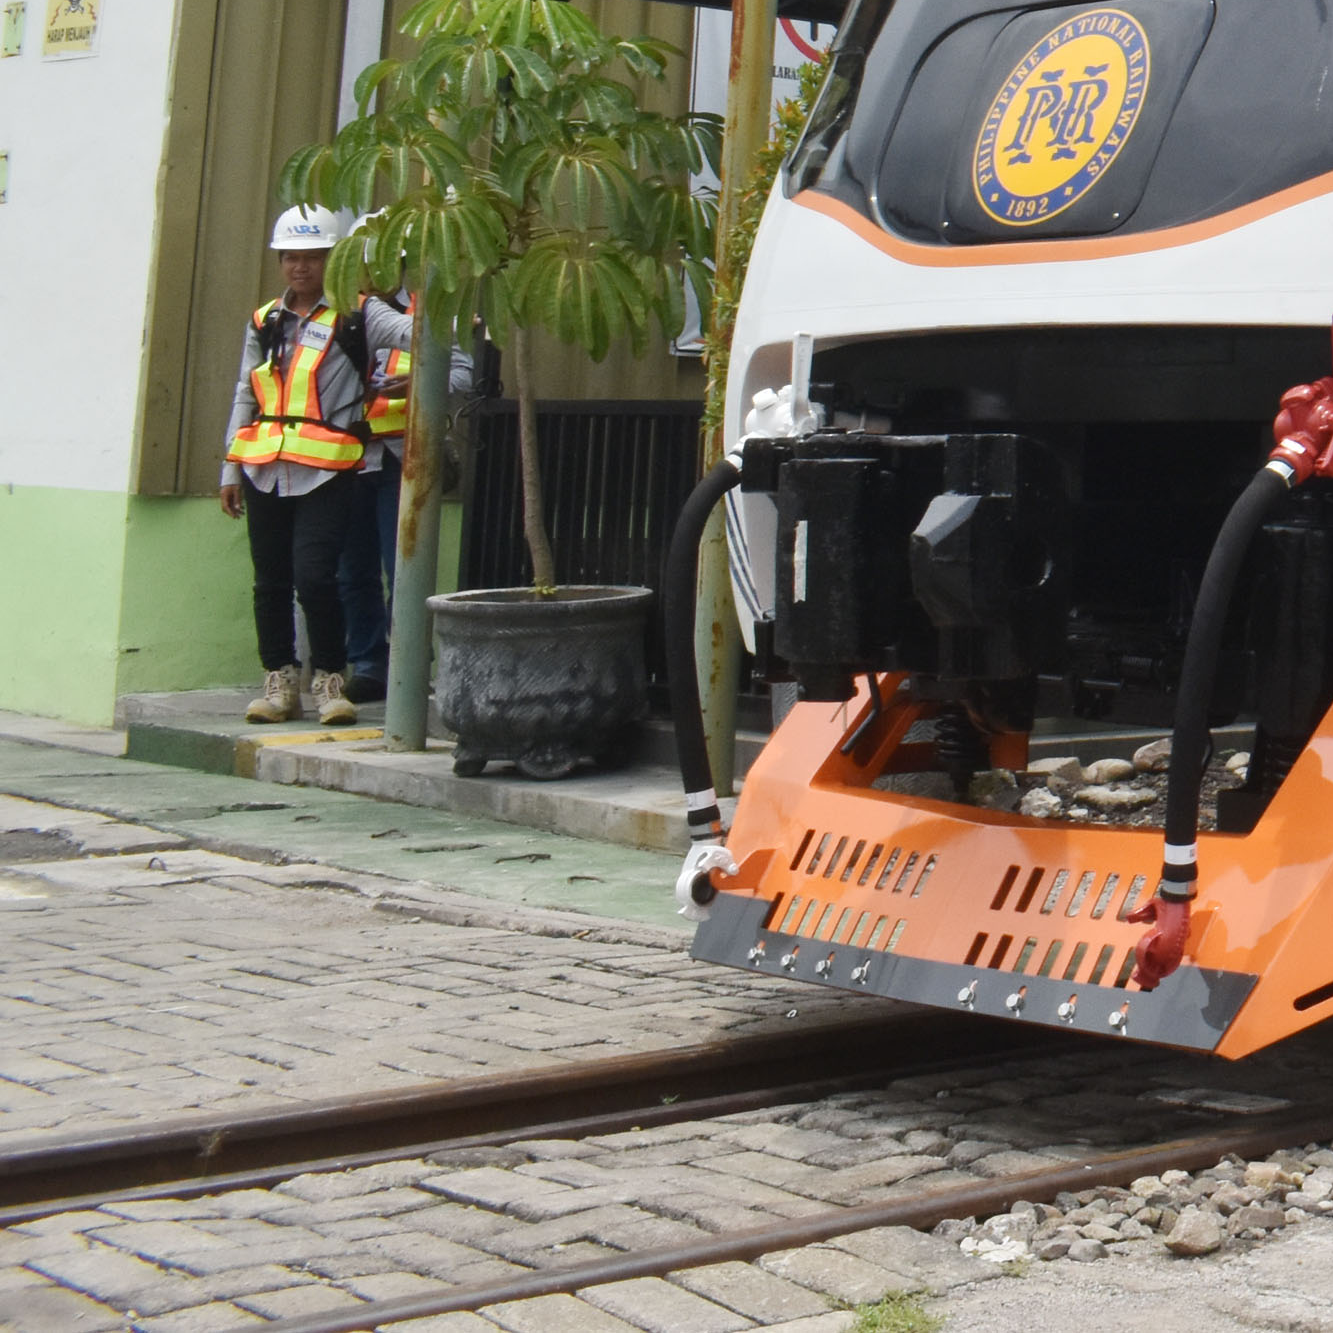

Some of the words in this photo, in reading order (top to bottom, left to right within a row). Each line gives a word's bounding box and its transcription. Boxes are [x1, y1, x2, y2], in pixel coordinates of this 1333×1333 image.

[1048, 15, 1137, 50] NATIONAL
[978, 50, 1042, 186] PHILIPPINE
[1086, 47, 1145, 177] RAILWAYS
[1005, 196, 1049, 218] 1892
